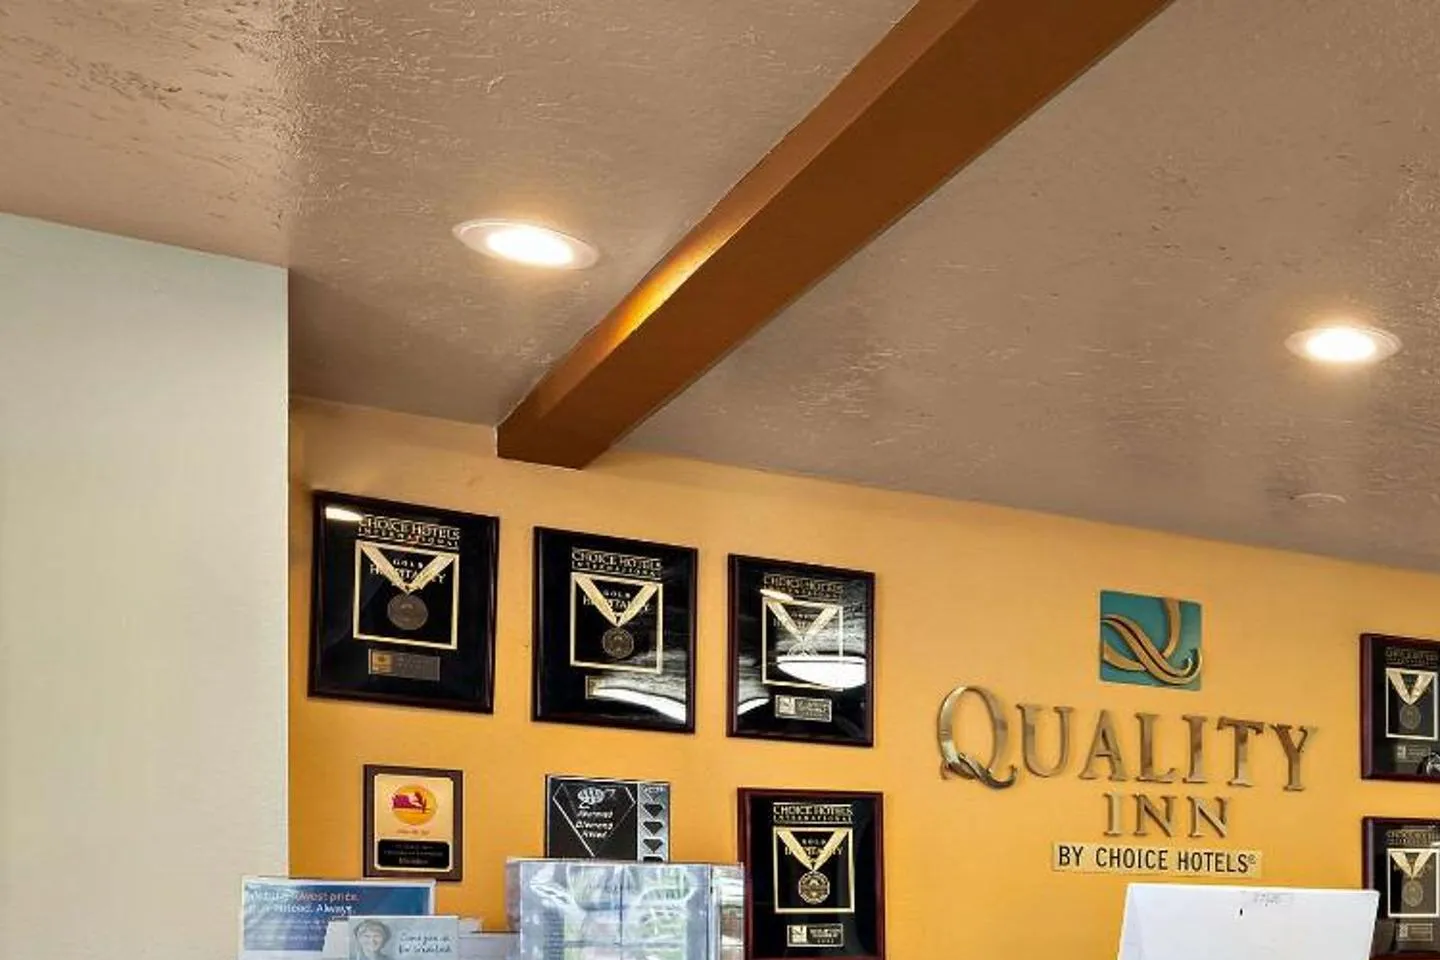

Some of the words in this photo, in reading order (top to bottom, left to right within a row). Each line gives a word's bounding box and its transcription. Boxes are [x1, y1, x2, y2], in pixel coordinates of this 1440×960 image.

[937, 685, 1317, 792] QUALITY
[1102, 792, 1230, 838] INN
[1058, 845, 1085, 868] BY
[1095, 847, 1169, 870] CHOICE
